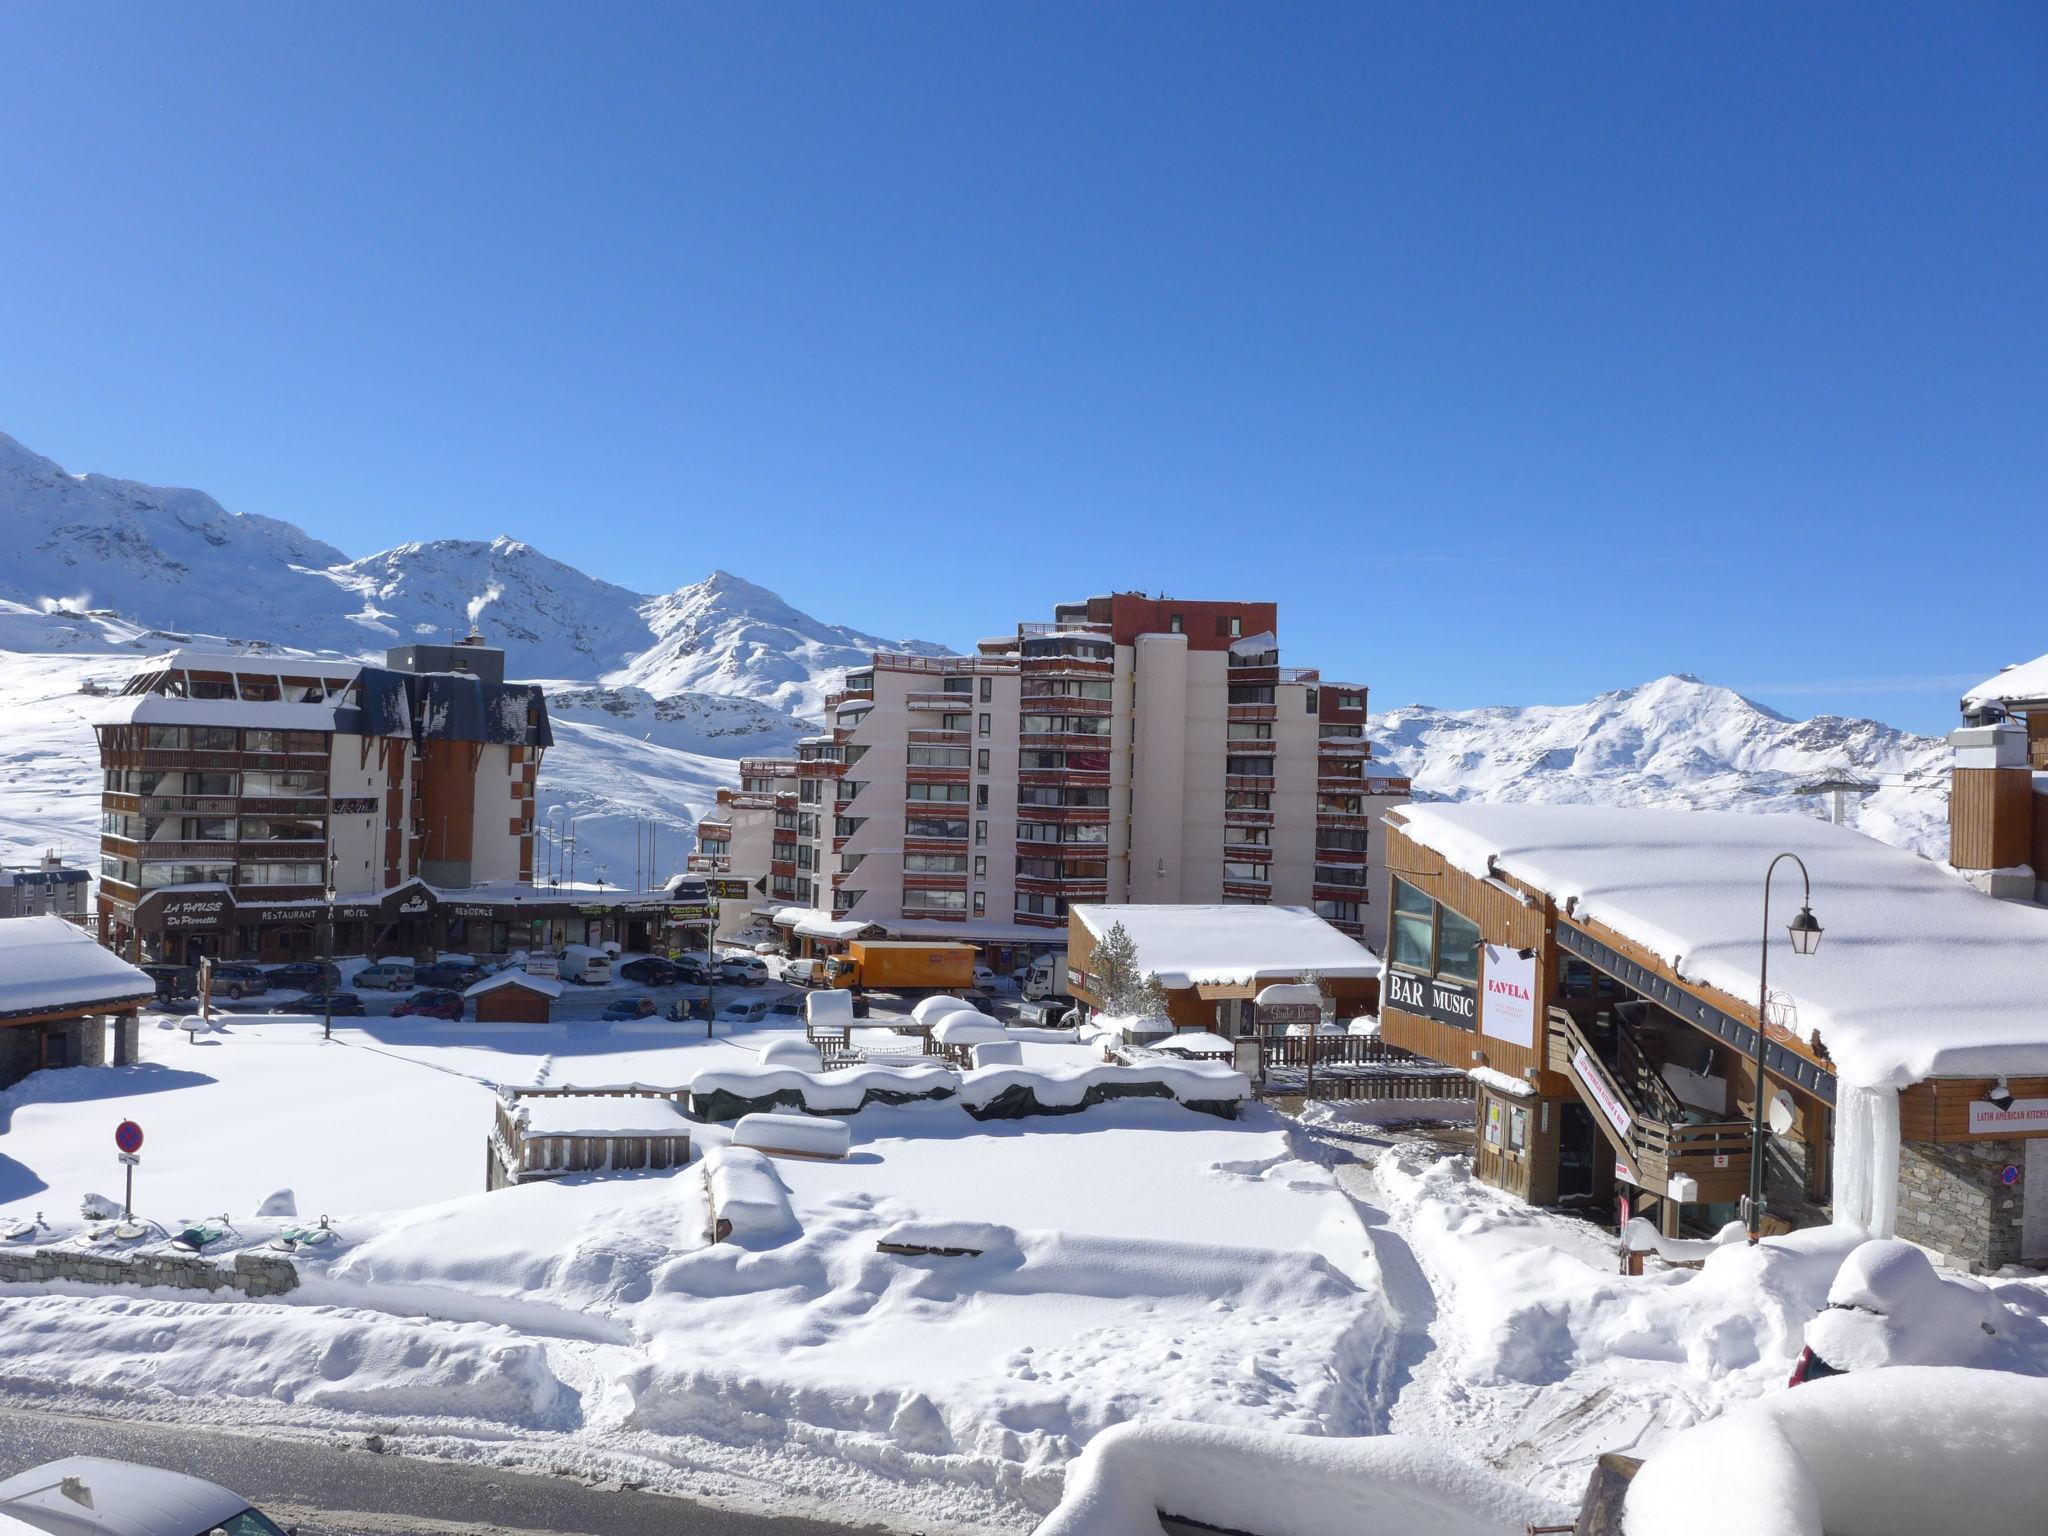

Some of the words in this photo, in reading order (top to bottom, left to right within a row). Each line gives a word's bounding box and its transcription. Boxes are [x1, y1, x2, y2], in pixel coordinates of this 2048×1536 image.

[162, 903, 180, 913] LA
[183, 902, 223, 912] PAUSE
[455, 908, 493, 916] RESIDENCE
[625, 905, 665, 913] Supermarket
[262, 910, 317, 920] RESTAURANT
[1488, 979, 1530, 1001] FAVELA
[1390, 975, 1424, 1008] BAR
[1432, 989, 1474, 1018] MUSIC
[1977, 1112, 1994, 1121] LATIN
[1996, 1111, 2024, 1120] AMERICAN
[2027, 1110, 2048, 1119] KITCHE
